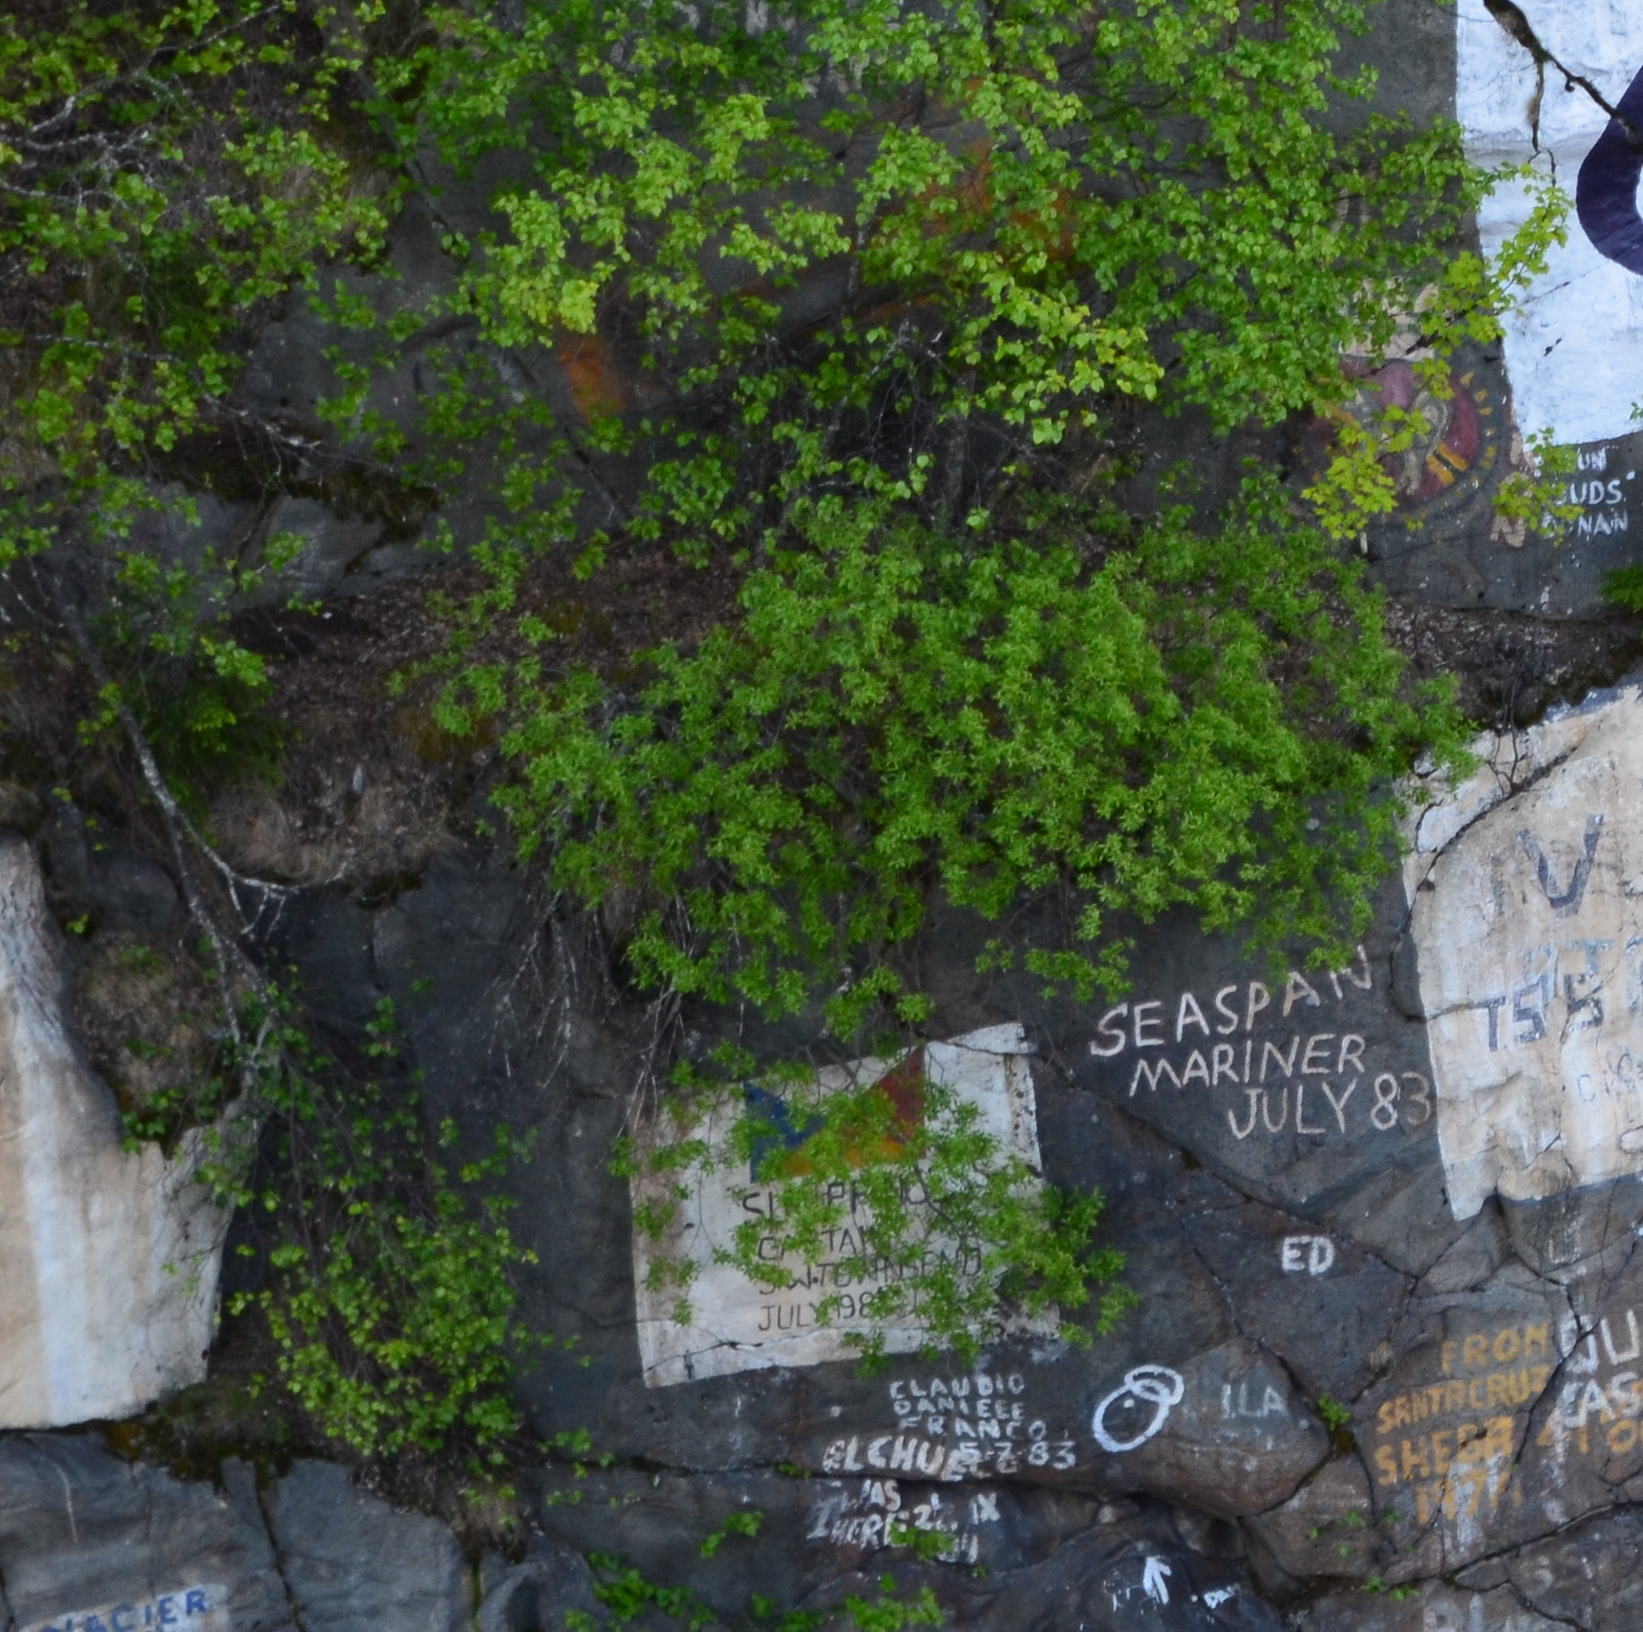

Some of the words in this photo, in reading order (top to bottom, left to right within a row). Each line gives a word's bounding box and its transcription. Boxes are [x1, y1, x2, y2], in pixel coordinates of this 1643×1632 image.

[1091, 946, 1371, 1060] SEASPAN
[1128, 1034, 1366, 1097] MARINER
[1228, 1080, 1359, 1141] JULY
[1370, 1073, 1433, 1132] 83
[1282, 1235, 1335, 1276] ED
[1441, 1321, 1552, 1372] FROM
[1375, 1415, 1514, 1486] SHEBA
